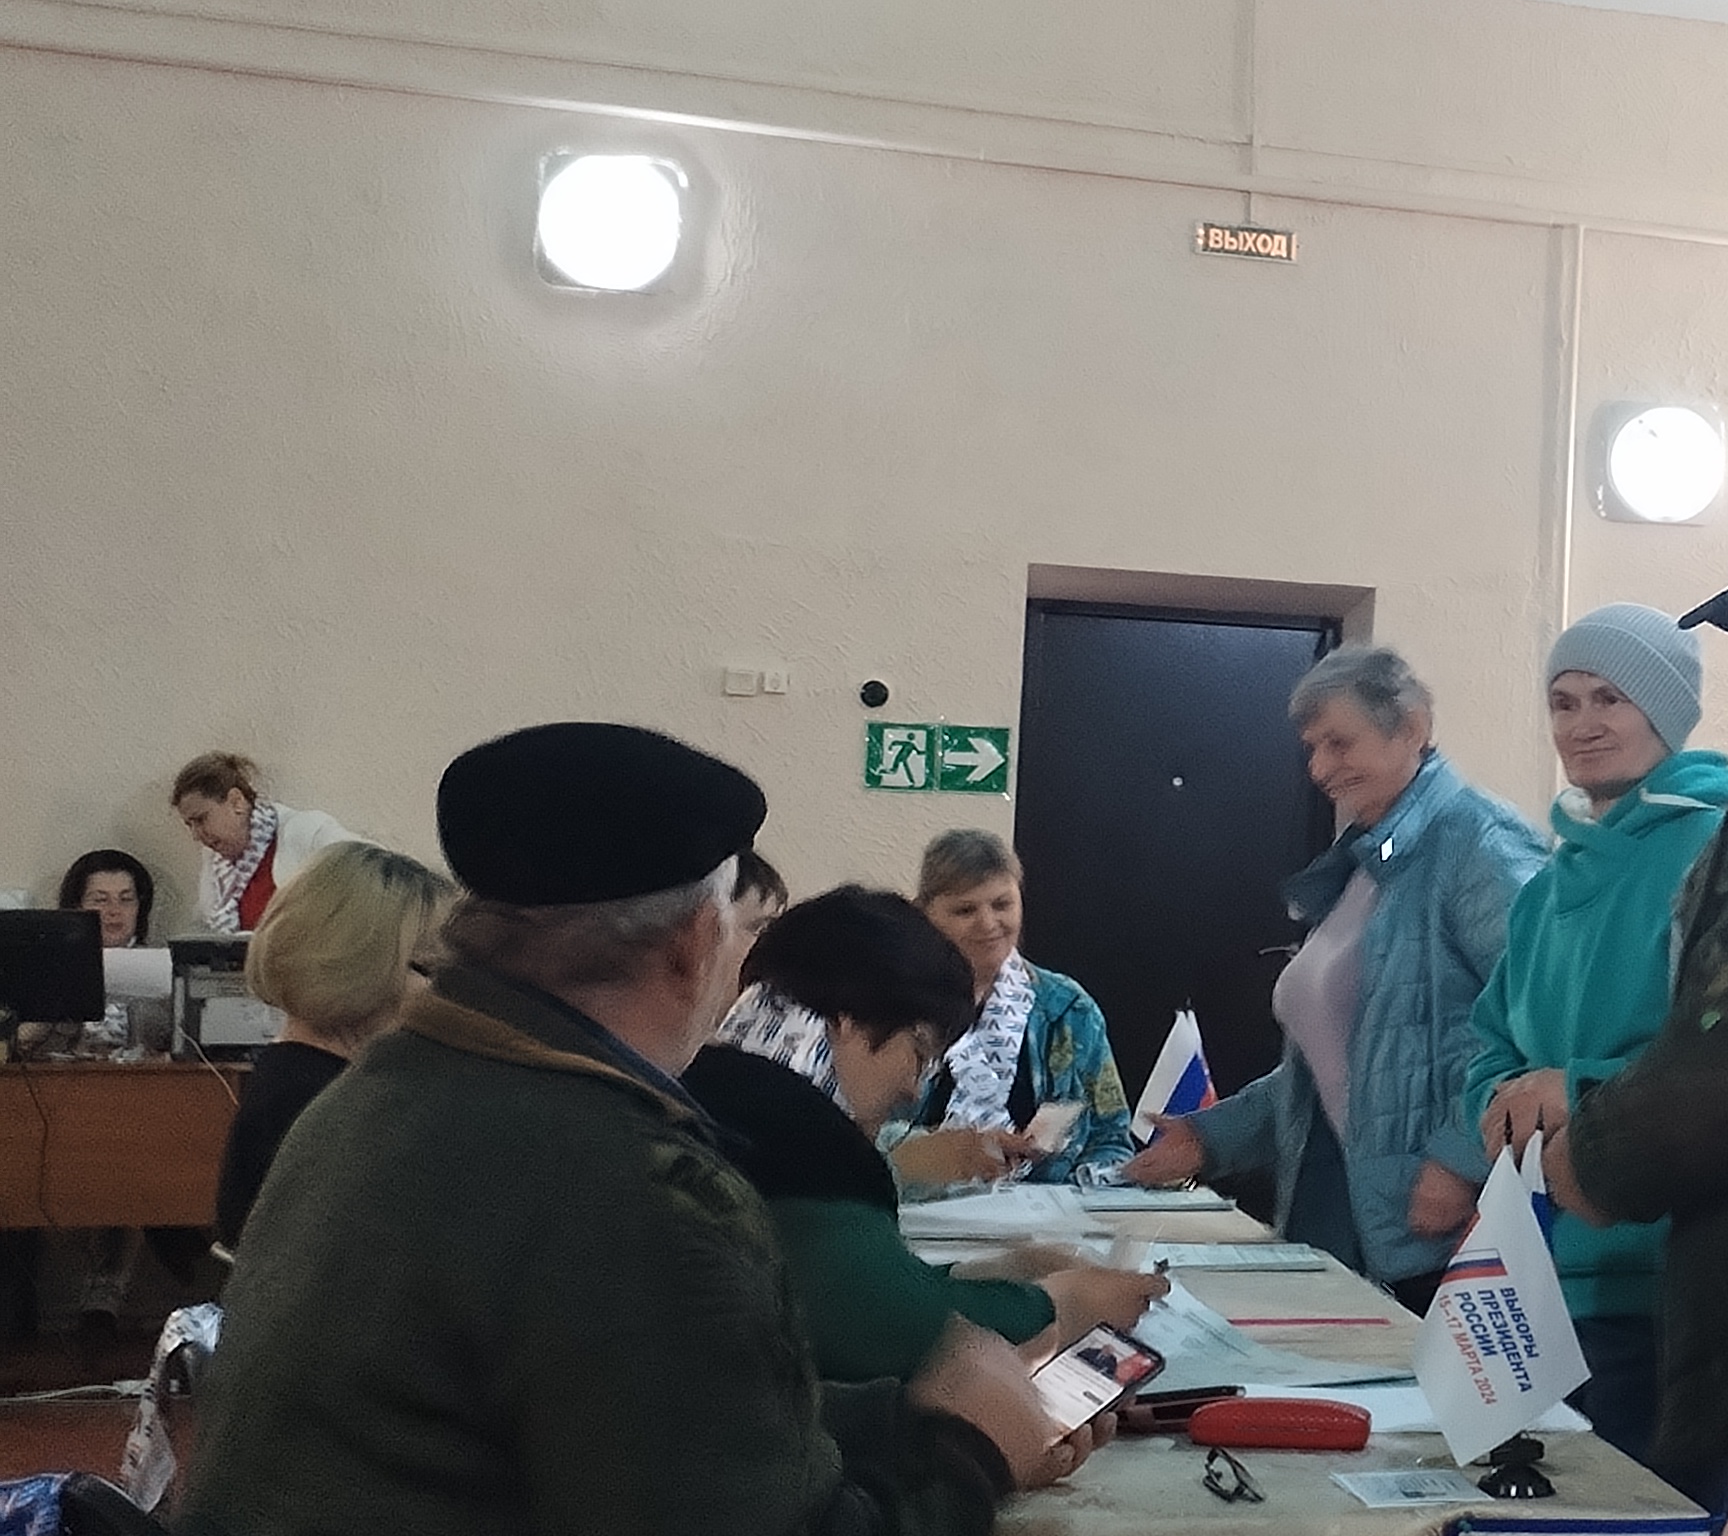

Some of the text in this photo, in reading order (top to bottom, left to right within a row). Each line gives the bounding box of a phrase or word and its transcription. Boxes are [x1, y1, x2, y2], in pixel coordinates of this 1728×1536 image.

[1209, 228, 1287, 257] ВЫХОД
[1454, 1291, 1498, 1356] РОССИИ
[1477, 1289, 1532, 1393] ПРЕЗИДЕНТА
[1500, 1287, 1539, 1359] ВЫБОРЫ
[1454, 1333, 1483, 1375] МАРТА
[1473, 1376, 1498, 1405] 2024
